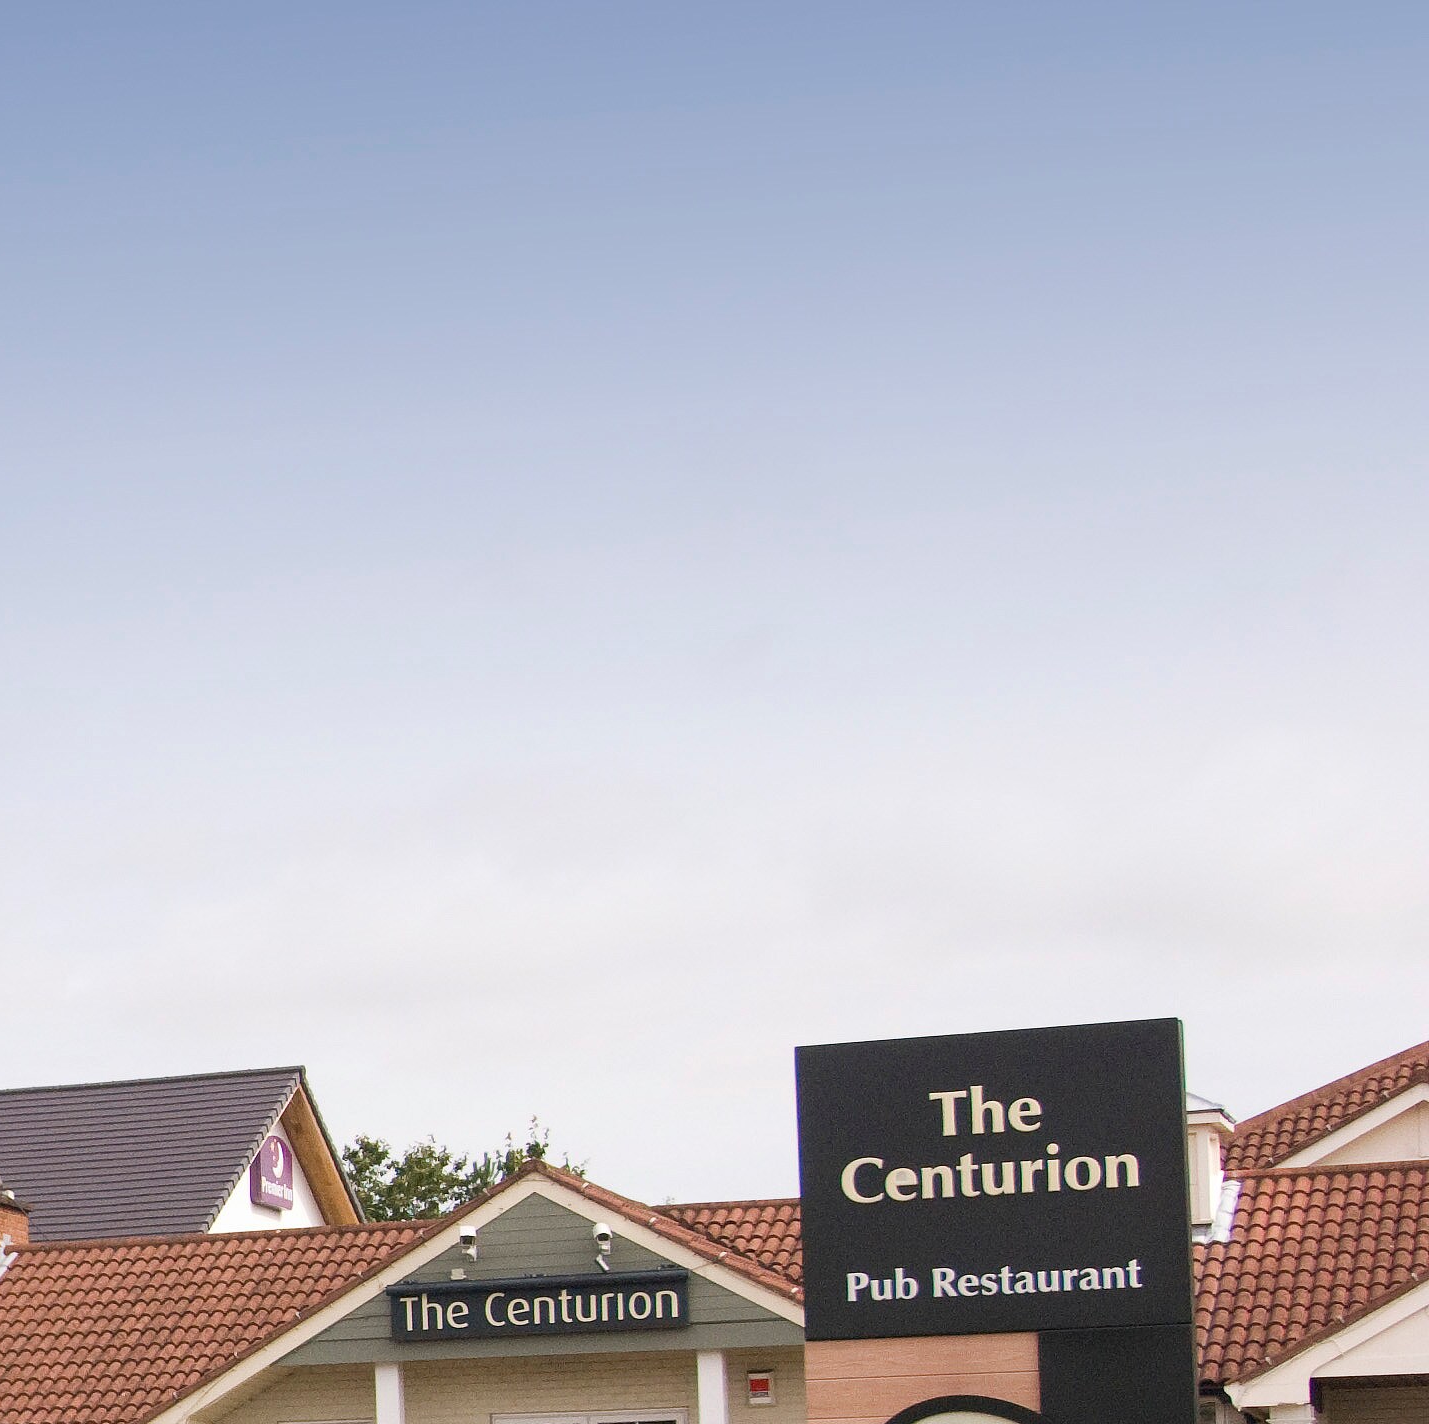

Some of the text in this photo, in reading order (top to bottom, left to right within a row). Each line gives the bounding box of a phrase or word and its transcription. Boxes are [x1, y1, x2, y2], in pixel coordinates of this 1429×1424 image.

[928, 1085, 1043, 1138] The
[840, 1142, 1141, 1204] Centurion
[846, 1258, 1143, 1303] Pub Restaurant
[399, 1289, 680, 1332] The Centurion
